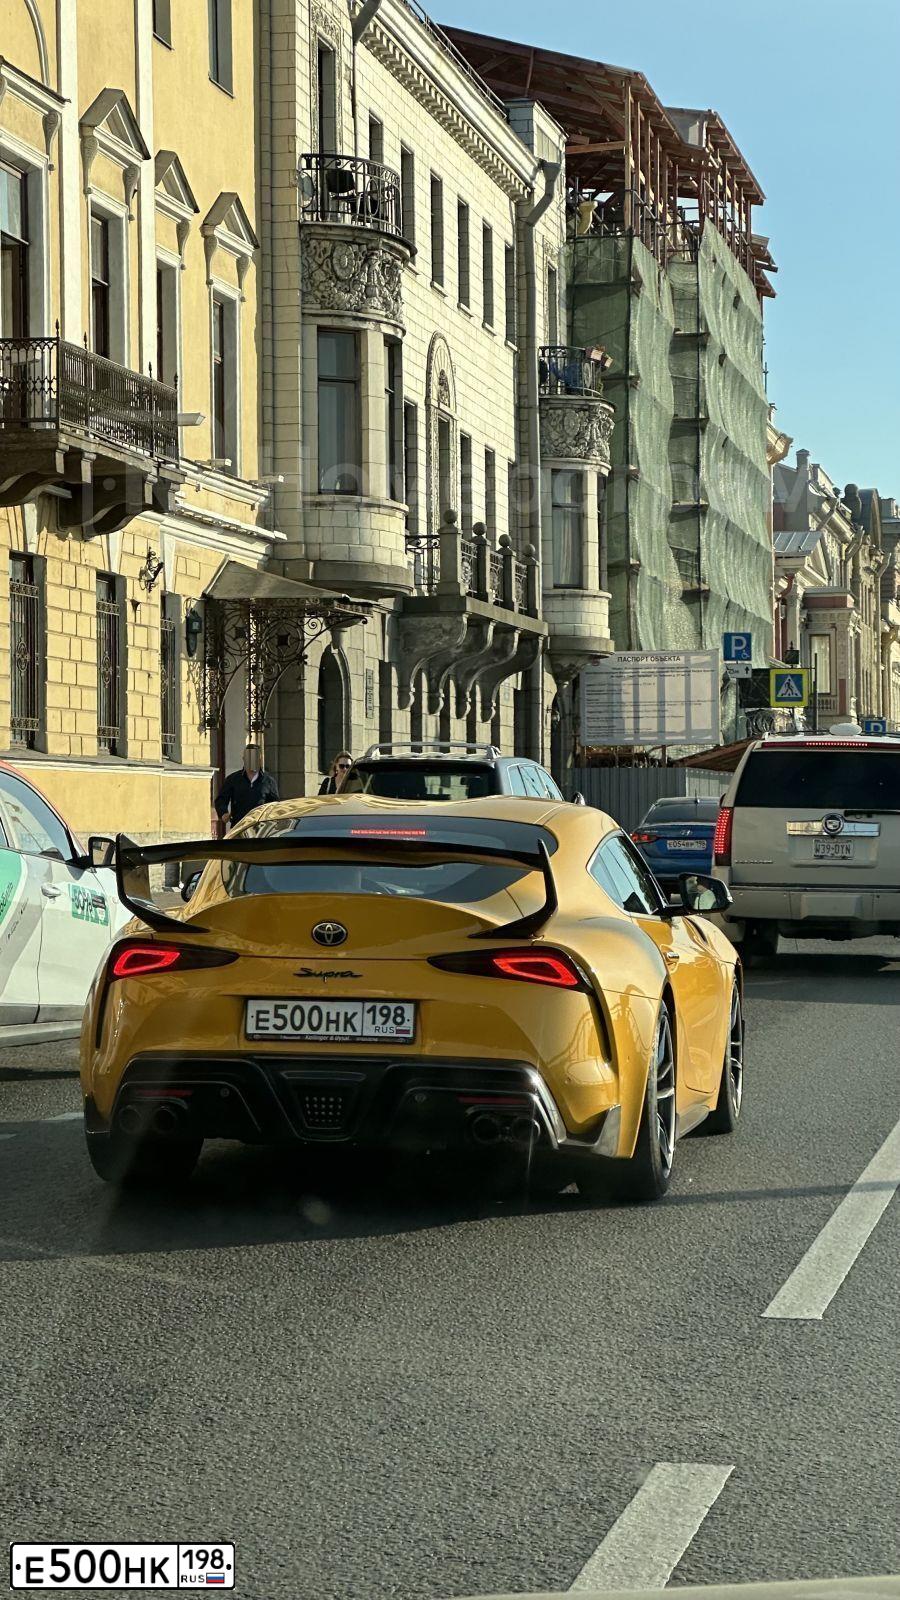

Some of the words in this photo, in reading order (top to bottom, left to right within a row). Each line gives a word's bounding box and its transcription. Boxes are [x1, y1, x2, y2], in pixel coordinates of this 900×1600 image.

[731, 635, 747, 657] P
[617, 655, 648, 663] ПАСПОРТ
[293, 967, 363, 982] Supra
[255, 1004, 358, 1033] Е500НК
[366, 1004, 406, 1026] 198
[374, 1026, 395, 1034] RUS
